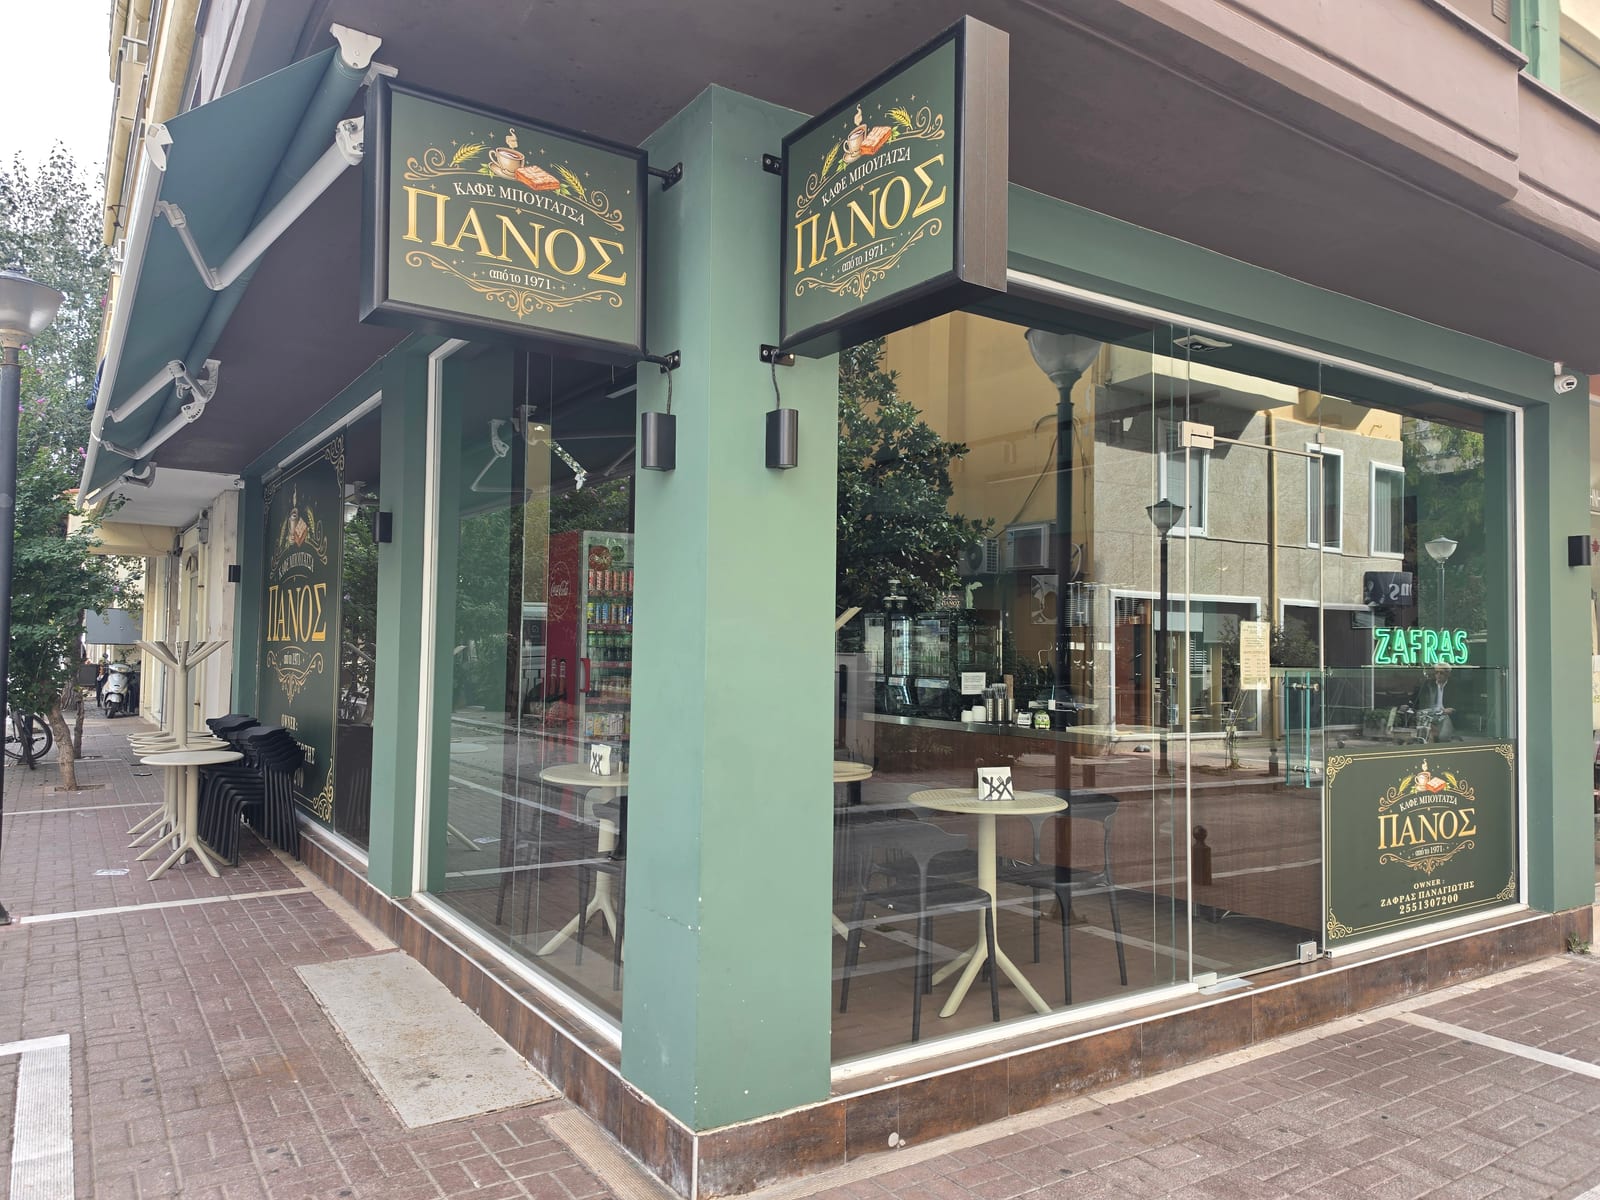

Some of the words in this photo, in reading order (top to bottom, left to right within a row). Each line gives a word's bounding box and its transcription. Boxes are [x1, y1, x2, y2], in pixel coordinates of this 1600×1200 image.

[821, 176, 847, 207] ΚΑΦΕ
[849, 146, 911, 185] ΜΠΟΥΓΑΤΣΑ
[453, 182, 496, 197] ΚΑΦΕ
[499, 186, 585, 226] ΜΠΟΥΓΑΤΣΑ
[794, 153, 947, 275] ΠΑΝΟΣ
[402, 185, 627, 287] ΠΑΝΟΣ
[865, 243, 884, 262] 1971
[524, 274, 551, 290] 1971
[267, 583, 326, 642] ΠΑΝΟΣ
[1374, 628, 1468, 665] ZAFRAS
[1399, 797, 1419, 812] ΚΑΦΕ
[1378, 808, 1477, 849] ΠΑΝΟΣ
[1380, 893, 1417, 907] ΖΑΦΡΑΣ
[1418, 881, 1475, 899] ΠΑΝΑΓΙΩΤΗΣ
[1399, 893, 1459, 914] 2551307200
